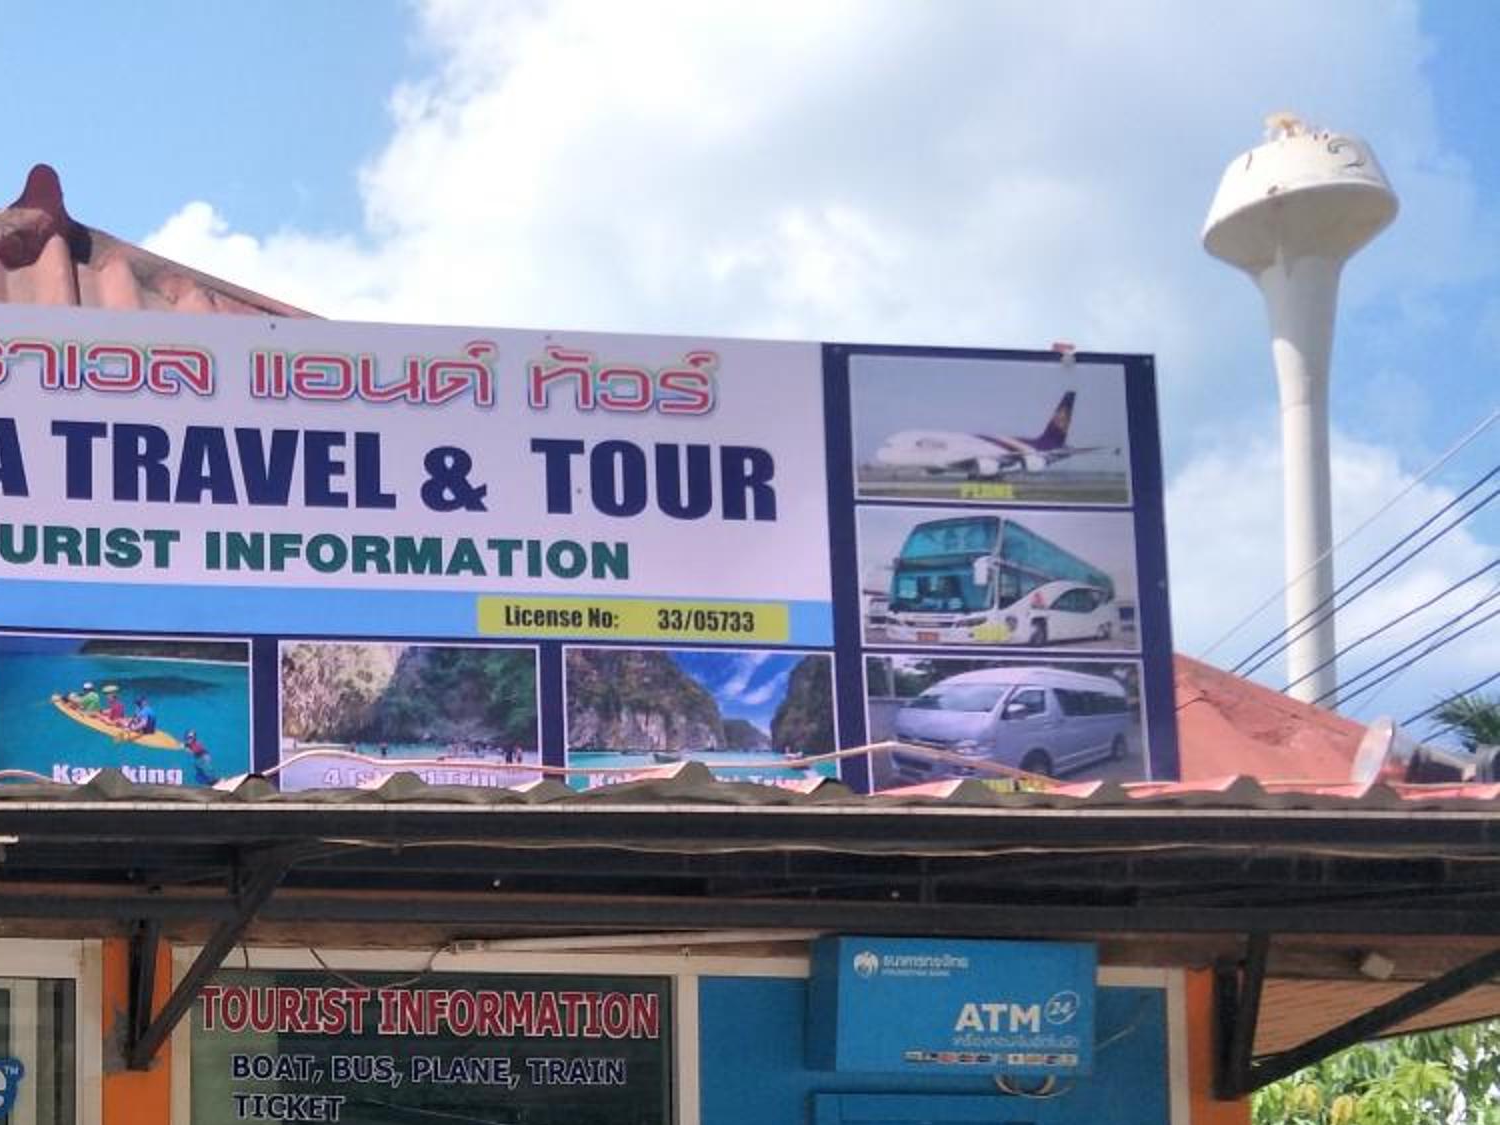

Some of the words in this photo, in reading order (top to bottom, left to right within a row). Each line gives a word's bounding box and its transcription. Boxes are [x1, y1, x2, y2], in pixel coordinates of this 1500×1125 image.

[251, 340, 497, 406] แอนด์
[529, 345, 718, 415] ทัวร์
[52, 421, 397, 510] TRAVEL
[420, 446, 487, 513] &
[531, 438, 777, 522] TOUR
[206, 531, 630, 580] INFORMATION
[504, 605, 583, 629] License
[657, 608, 755, 634] 33/05733
[52, 763, 184, 786] Kaking
[199, 985, 374, 1034] TOURIST
[380, 988, 660, 1039] INFORMATION
[955, 1002, 1041, 1034] ATM
[231, 1054, 324, 1084] BOAT,
[330, 1055, 403, 1088] BUS,
[411, 1057, 521, 1090] PLANE,
[526, 1058, 627, 1086] TRAIN
[231, 1094, 345, 1122] TICKET
